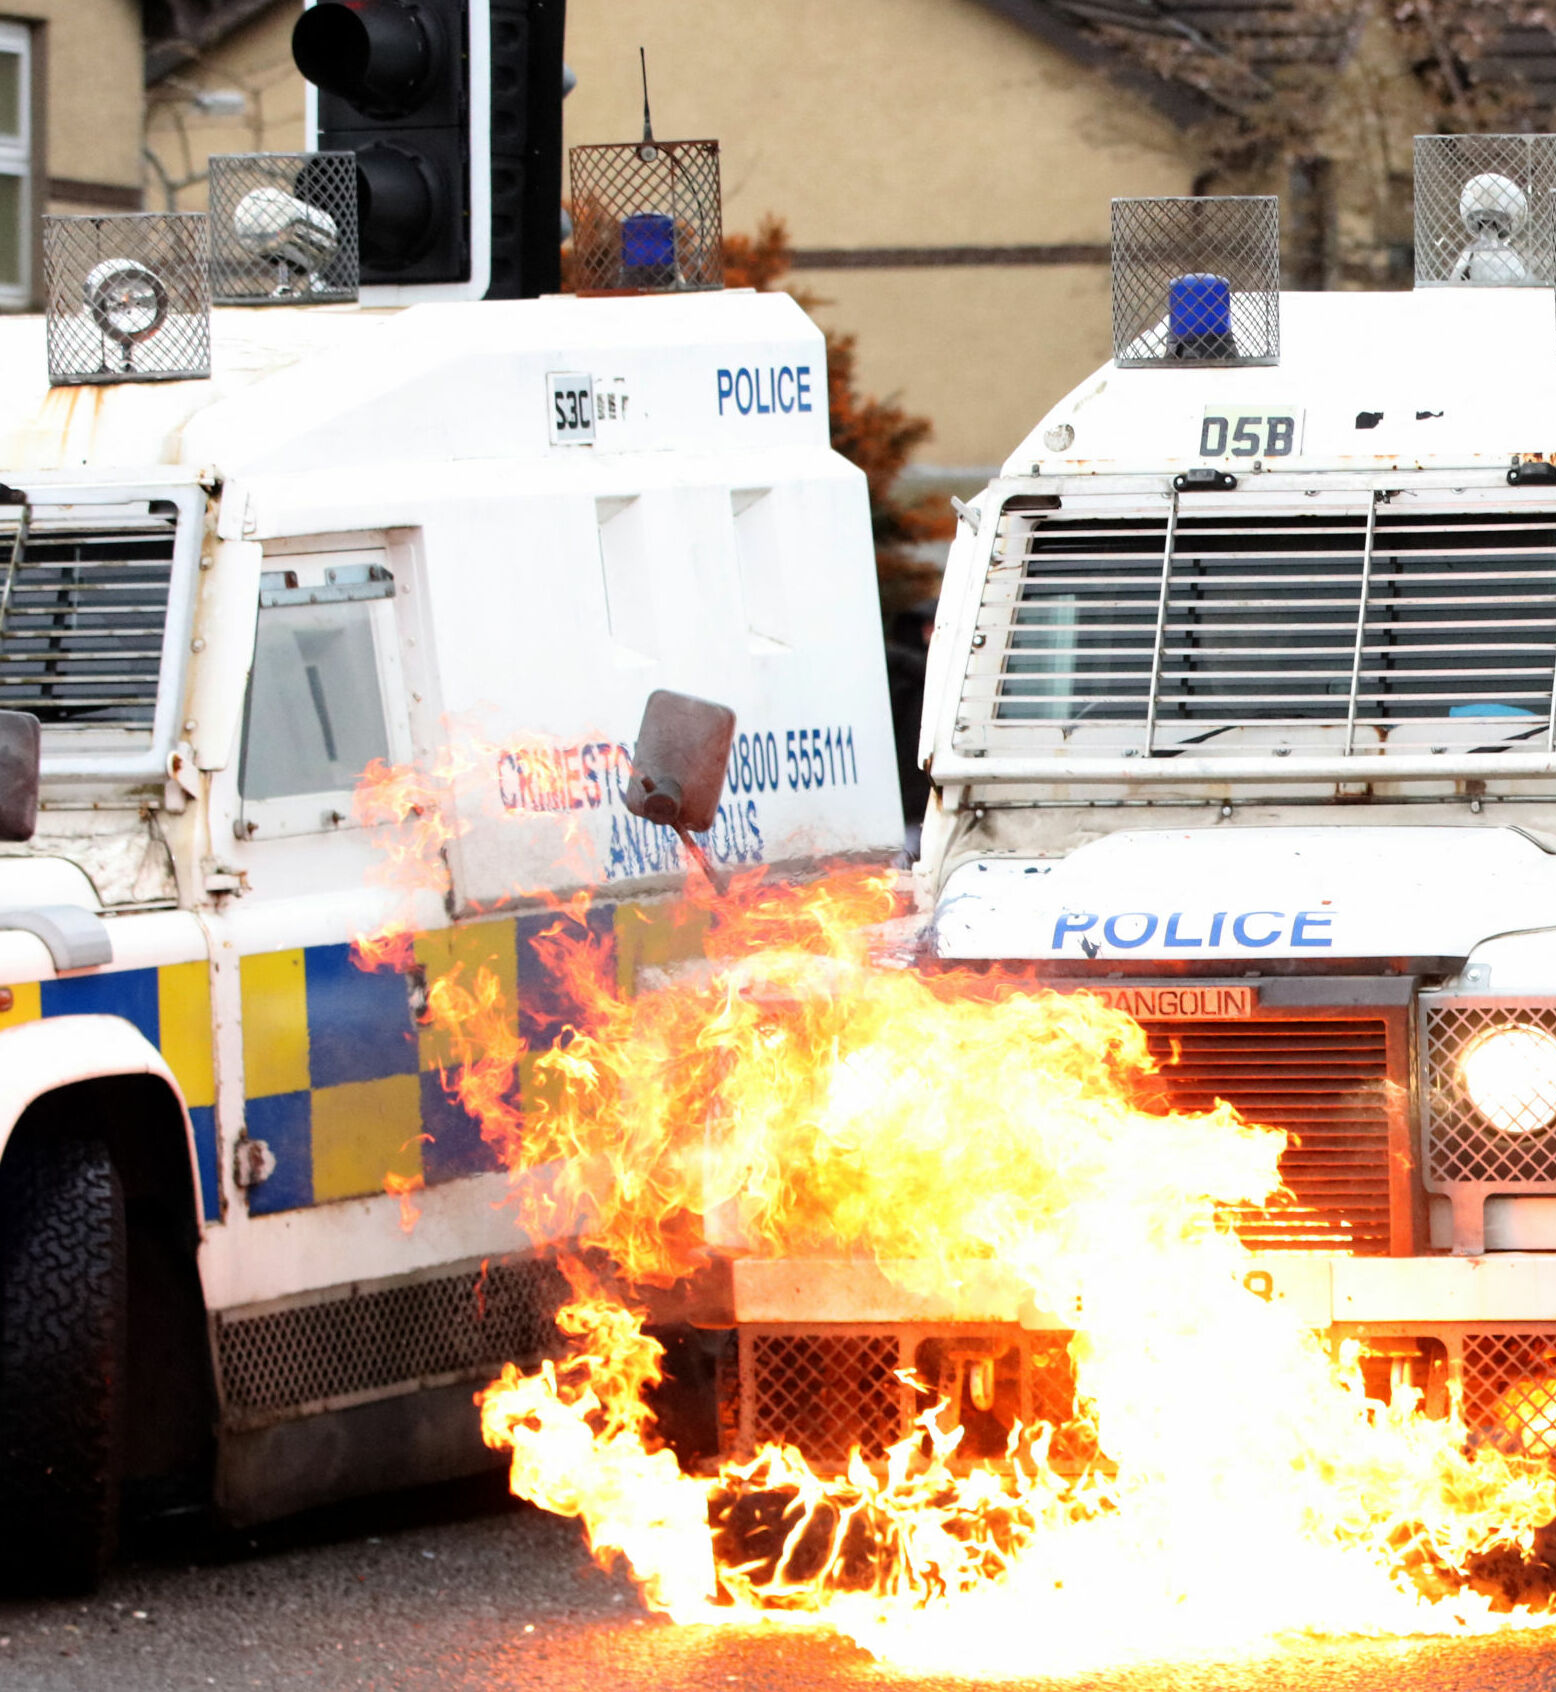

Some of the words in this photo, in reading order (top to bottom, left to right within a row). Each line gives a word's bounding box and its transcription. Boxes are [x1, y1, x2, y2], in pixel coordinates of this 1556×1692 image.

[555, 390, 591, 430] S3C
[717, 366, 812, 415] POLICE
[728, 731, 779, 795] 0800
[786, 724, 858, 793] 555111
[1051, 910, 1338, 950] POLICE
